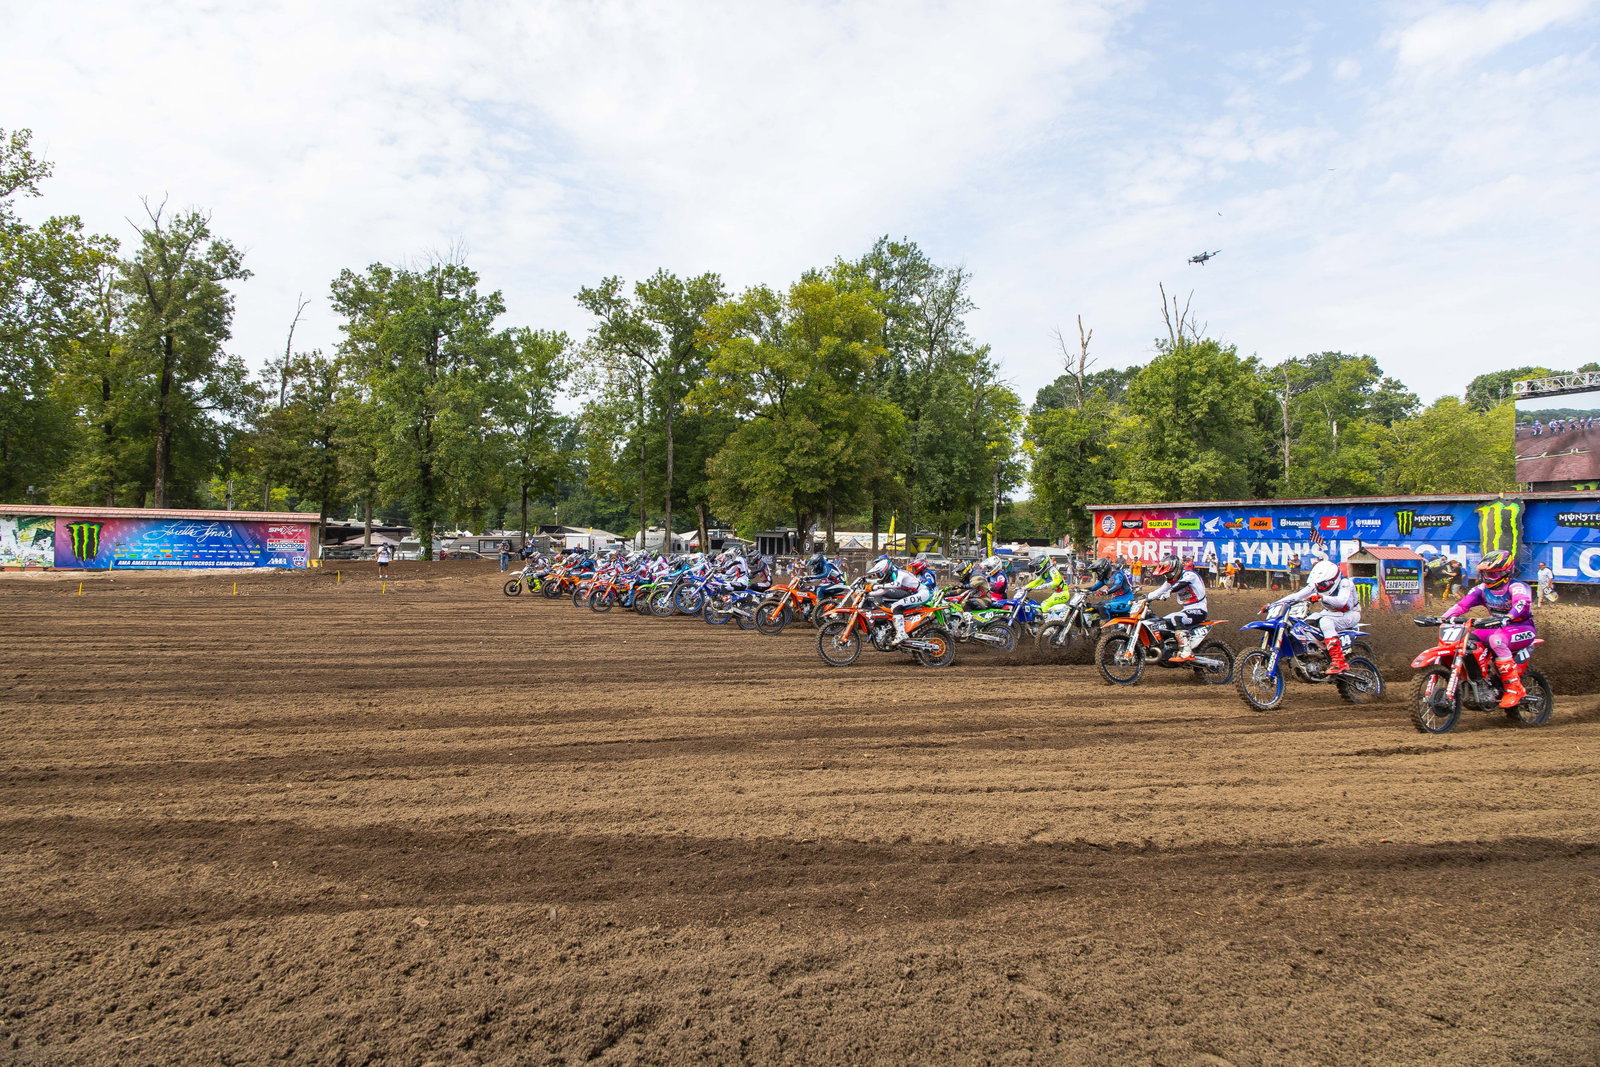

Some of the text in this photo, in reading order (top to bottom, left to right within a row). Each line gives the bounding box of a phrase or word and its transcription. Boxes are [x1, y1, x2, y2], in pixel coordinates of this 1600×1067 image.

[1116, 540, 1218, 563] LORETTA
[1227, 541, 1329, 565] LYNN'S
[903, 596, 923, 604] FOX
[1441, 628, 1462, 642] 11
